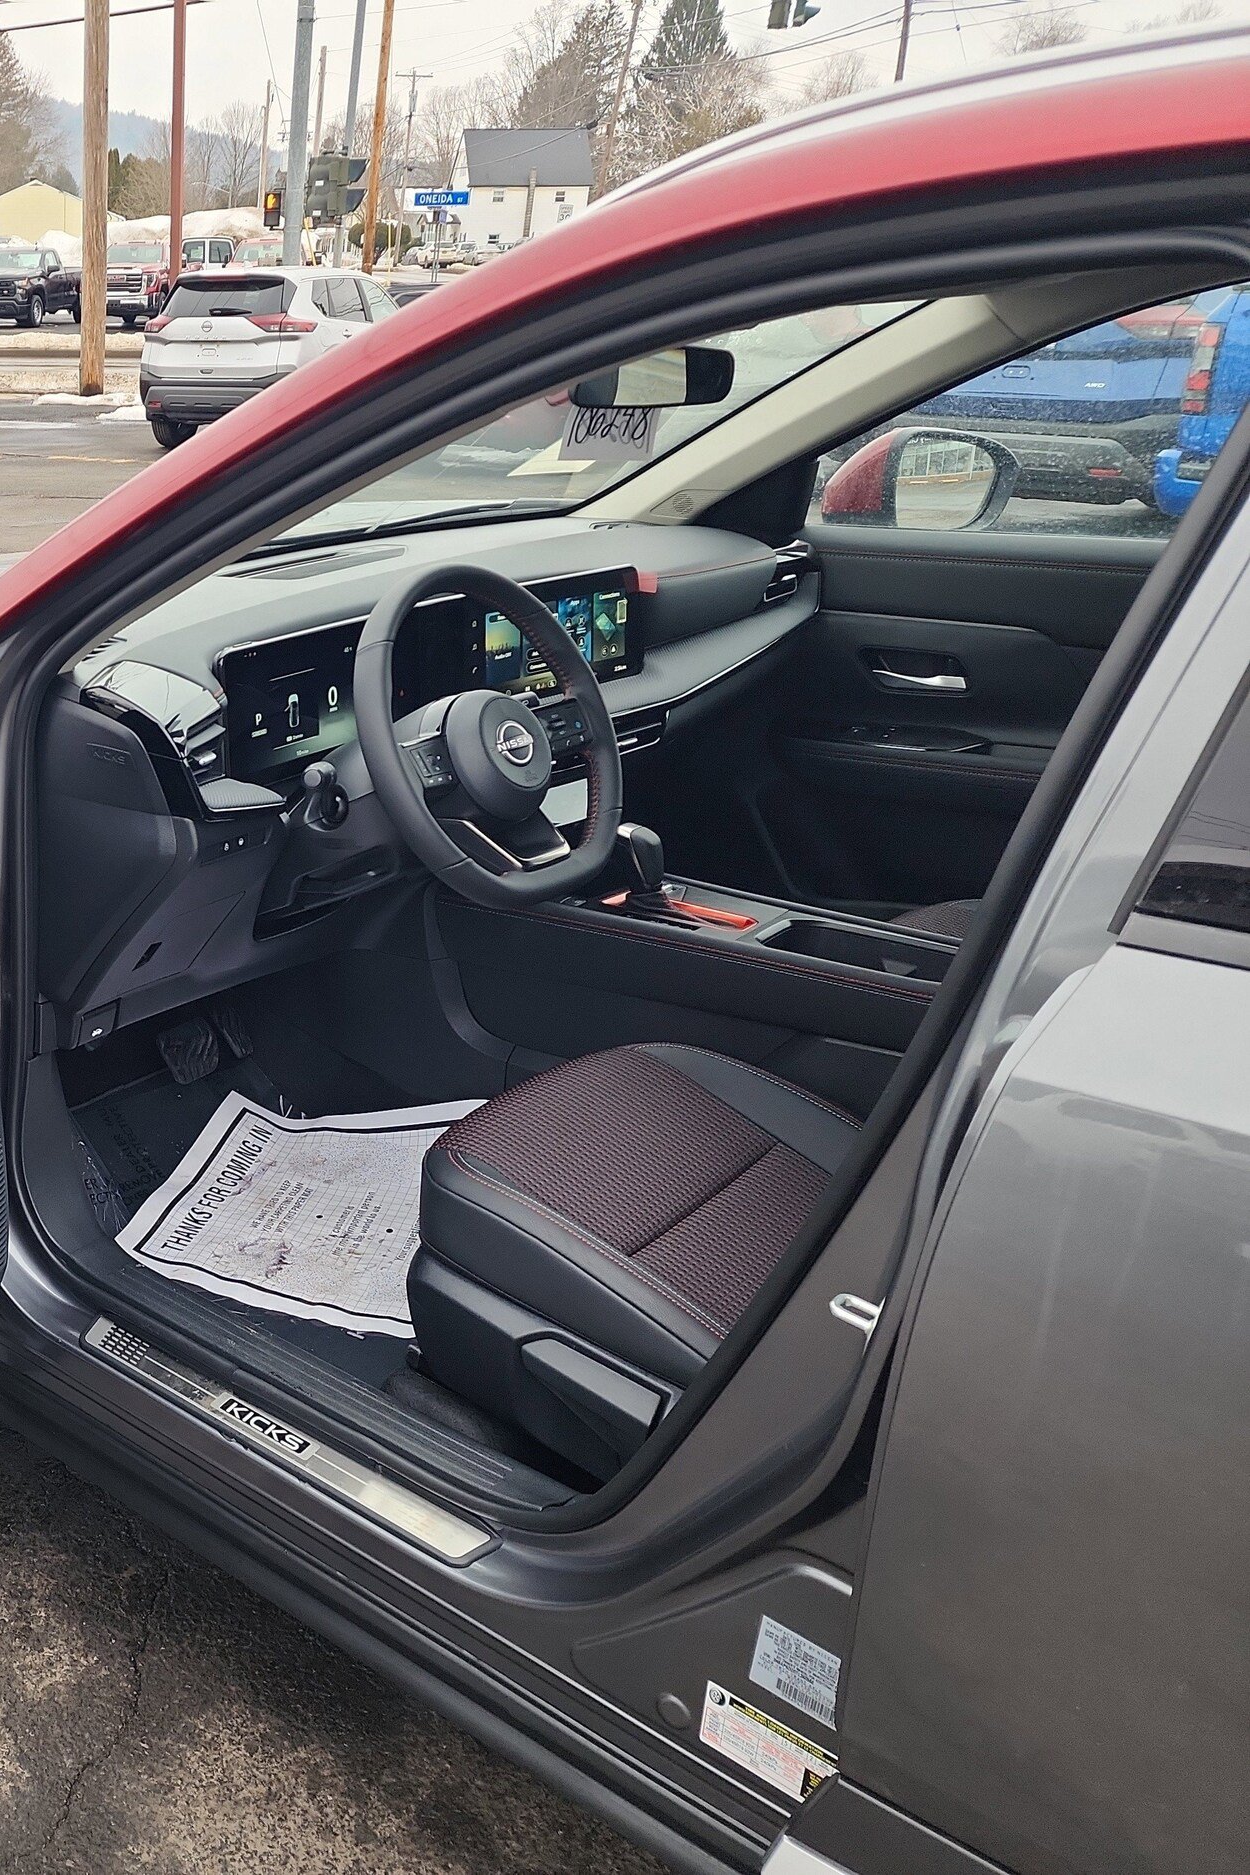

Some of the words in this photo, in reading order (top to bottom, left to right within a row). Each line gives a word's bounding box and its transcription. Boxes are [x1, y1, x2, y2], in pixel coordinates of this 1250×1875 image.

[419, 193, 453, 204] ONEIDA
[328, 686, 338, 706] 0
[255, 713, 262, 725] P
[161, 1207, 213, 1251] THANKS
[198, 1186, 231, 1209] FOR
[216, 1140, 264, 1187] COMING
[249, 1124, 273, 1143] IN
[226, 1402, 305, 1452] KICKS
